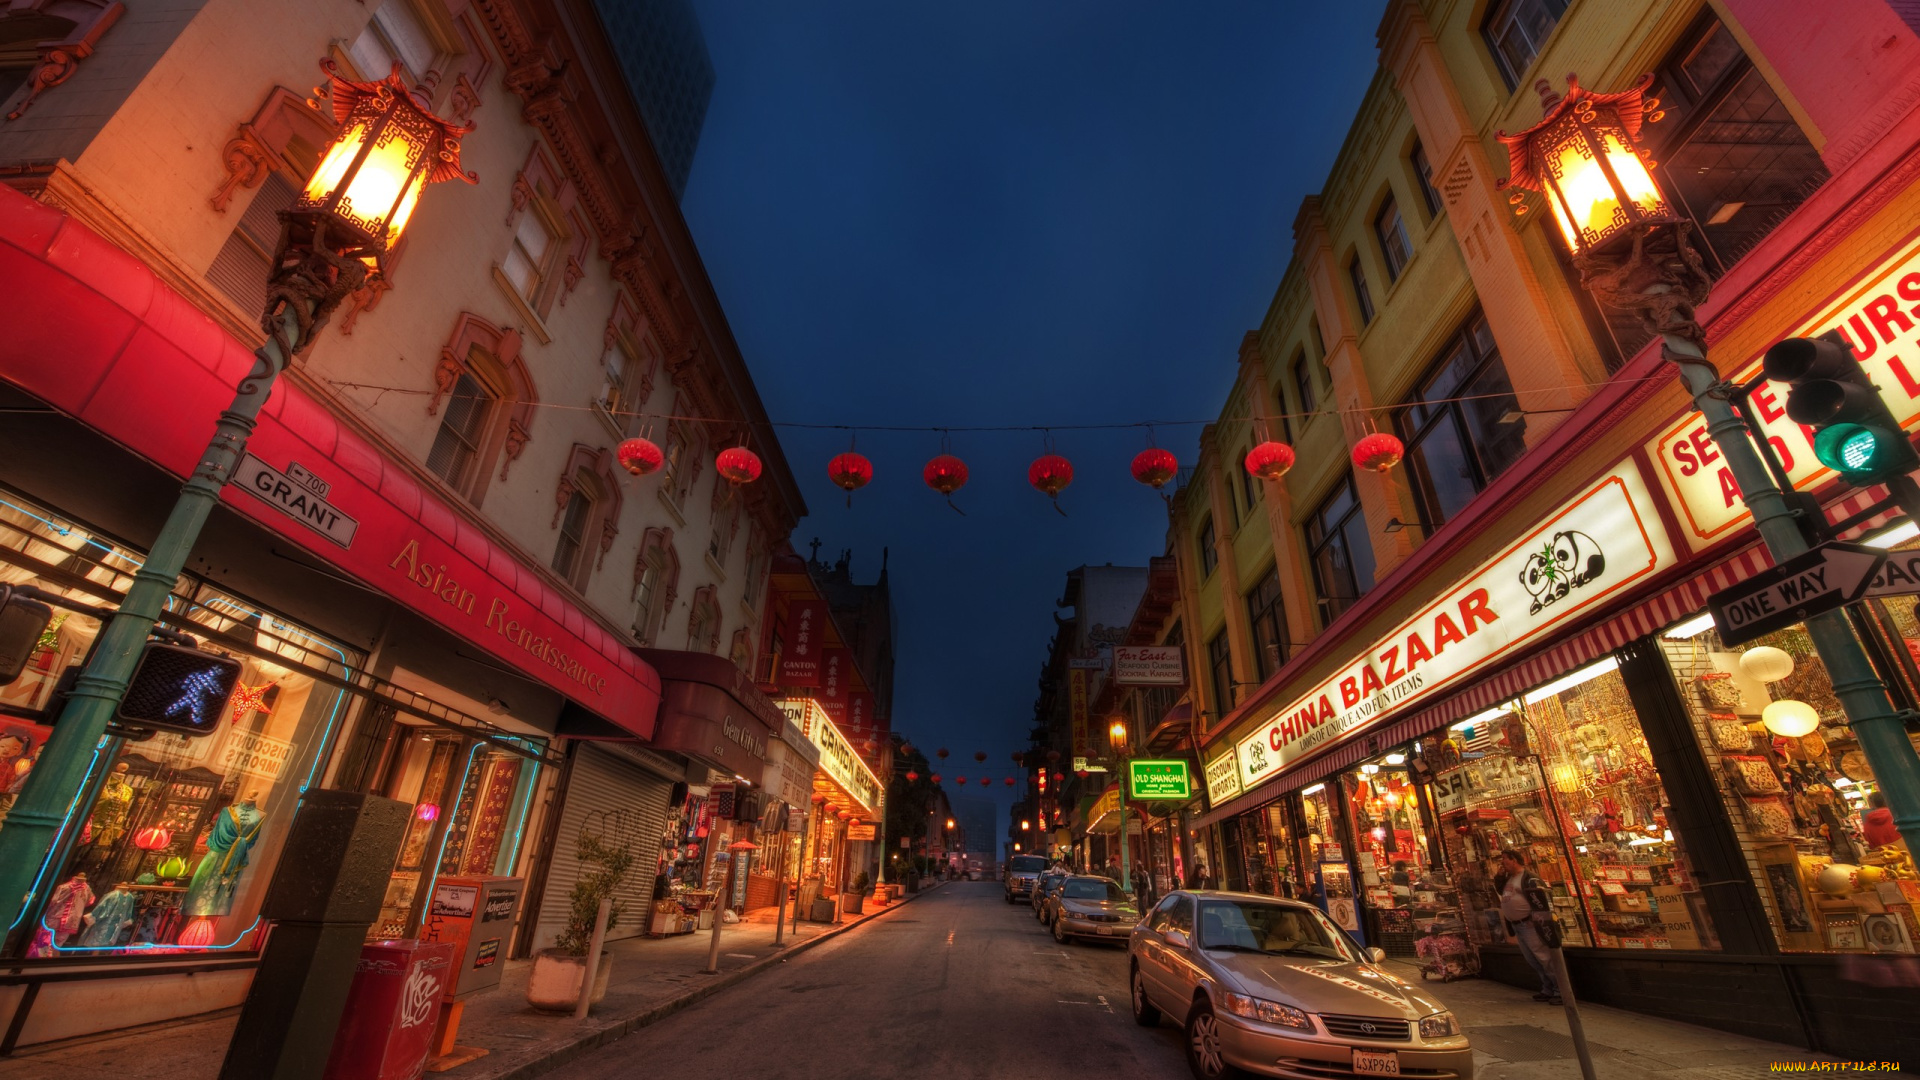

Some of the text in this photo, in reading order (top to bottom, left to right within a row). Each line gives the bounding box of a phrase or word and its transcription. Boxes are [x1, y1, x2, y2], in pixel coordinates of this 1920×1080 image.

[305, 473, 326, 495] 700
[255, 470, 340, 531] GRANT
[1729, 566, 1828, 625] ONE WAY
[389, 539, 606, 696] Asian Renaissance
[1117, 648, 1137, 660] Far
[1140, 649, 1167, 661] East
[783, 661, 817, 670] CANTON
[1117, 661, 1180, 669] SEAFOOD CUISINE
[1117, 669, 1182, 678] COCKTAIL KARAOKE
[1269, 587, 1500, 752] CHINA BAZAAR
[782, 708, 802, 720] ON
[821, 702, 844, 710] ANTON
[1316, 729, 1326, 741] OF
[1326, 712, 1354, 737] UNIQUE
[1355, 702, 1372, 722] AND
[1372, 690, 1392, 712] FUN
[1392, 673, 1424, 703] ITEMS
[723, 715, 740, 745] Gem
[740, 727, 754, 758] City
[820, 723, 855, 776] CANTON
[1207, 755, 1234, 779] DISCOUNT
[1135, 774, 1185, 784] OLD SHANGHAI
[1211, 775, 1237, 799] IMPORTS
[485, 899, 514, 913] Advertiser
[1656, 894, 1682, 904] FRONT
[1663, 922, 1691, 932] FRONT
[1356, 1056, 1397, 1073] 4SXP963
